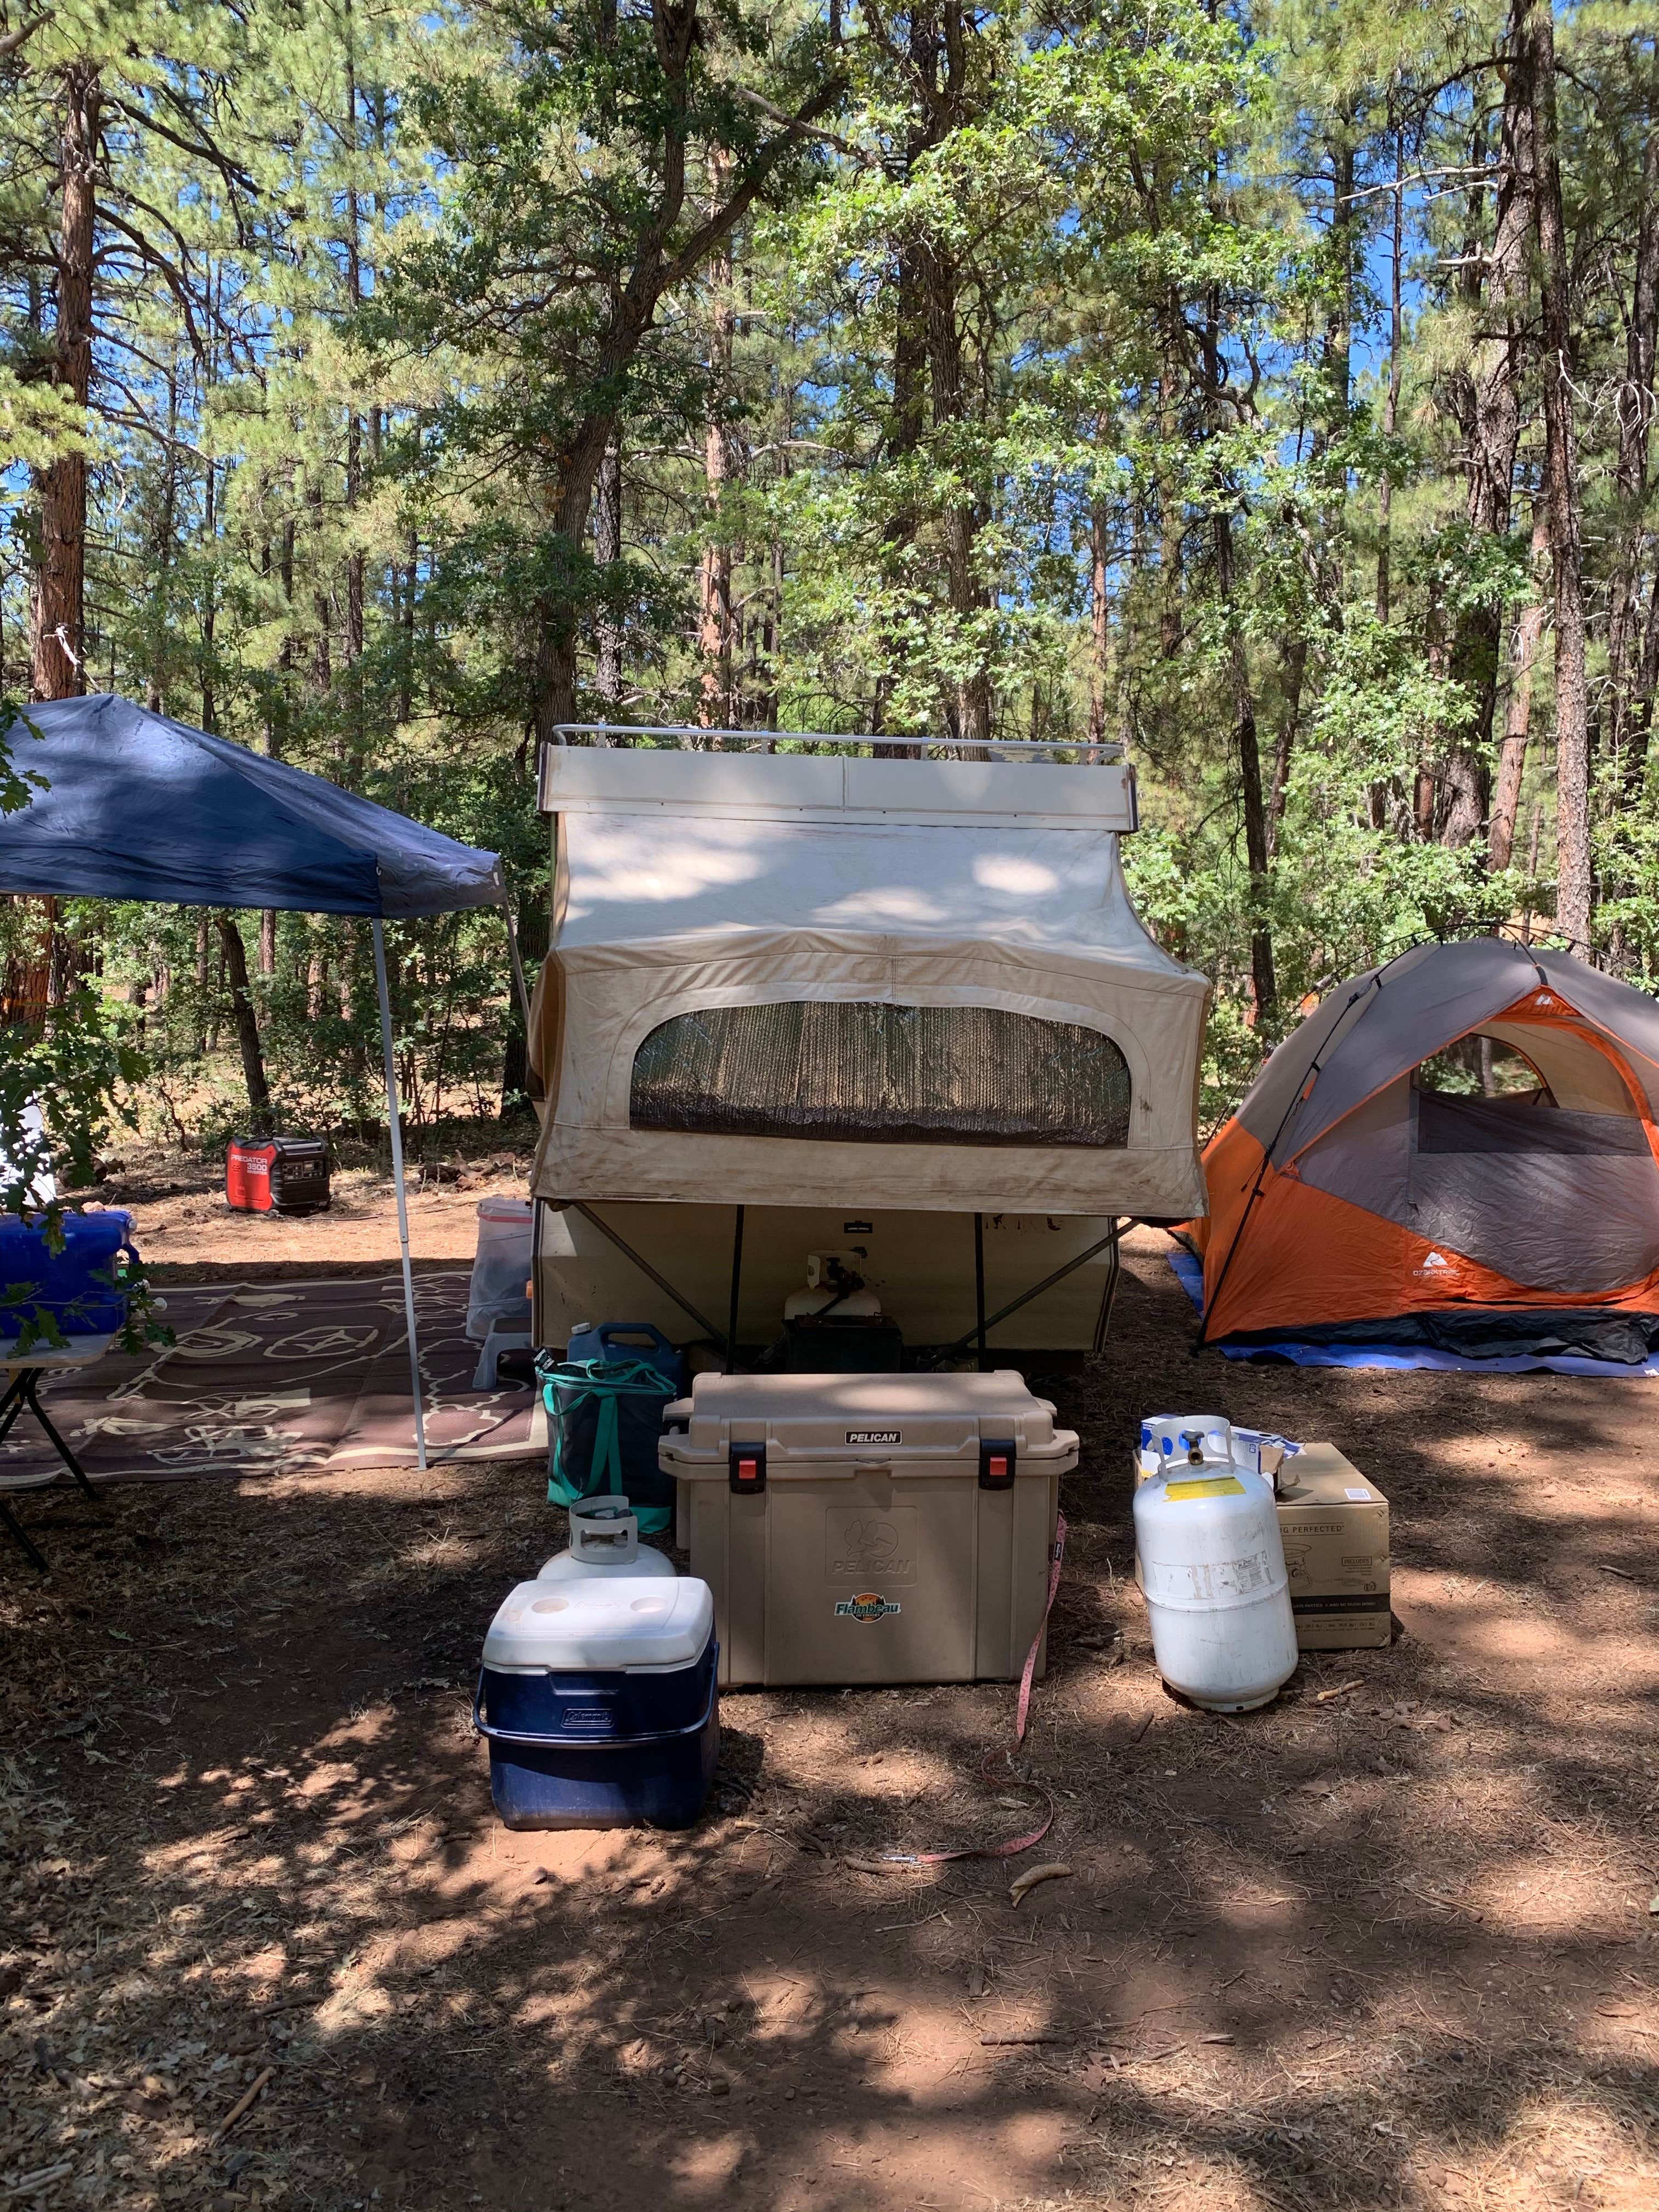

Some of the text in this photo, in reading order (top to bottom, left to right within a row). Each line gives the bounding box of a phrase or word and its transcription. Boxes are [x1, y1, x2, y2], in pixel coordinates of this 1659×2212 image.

[231, 1154, 268, 1164] PREDATOR
[247, 1163, 267, 1171] 3500
[850, 1433, 897, 1442] PELICAN
[832, 1560, 910, 1575] PELICAN
[836, 1603, 899, 1614] Flambeau
